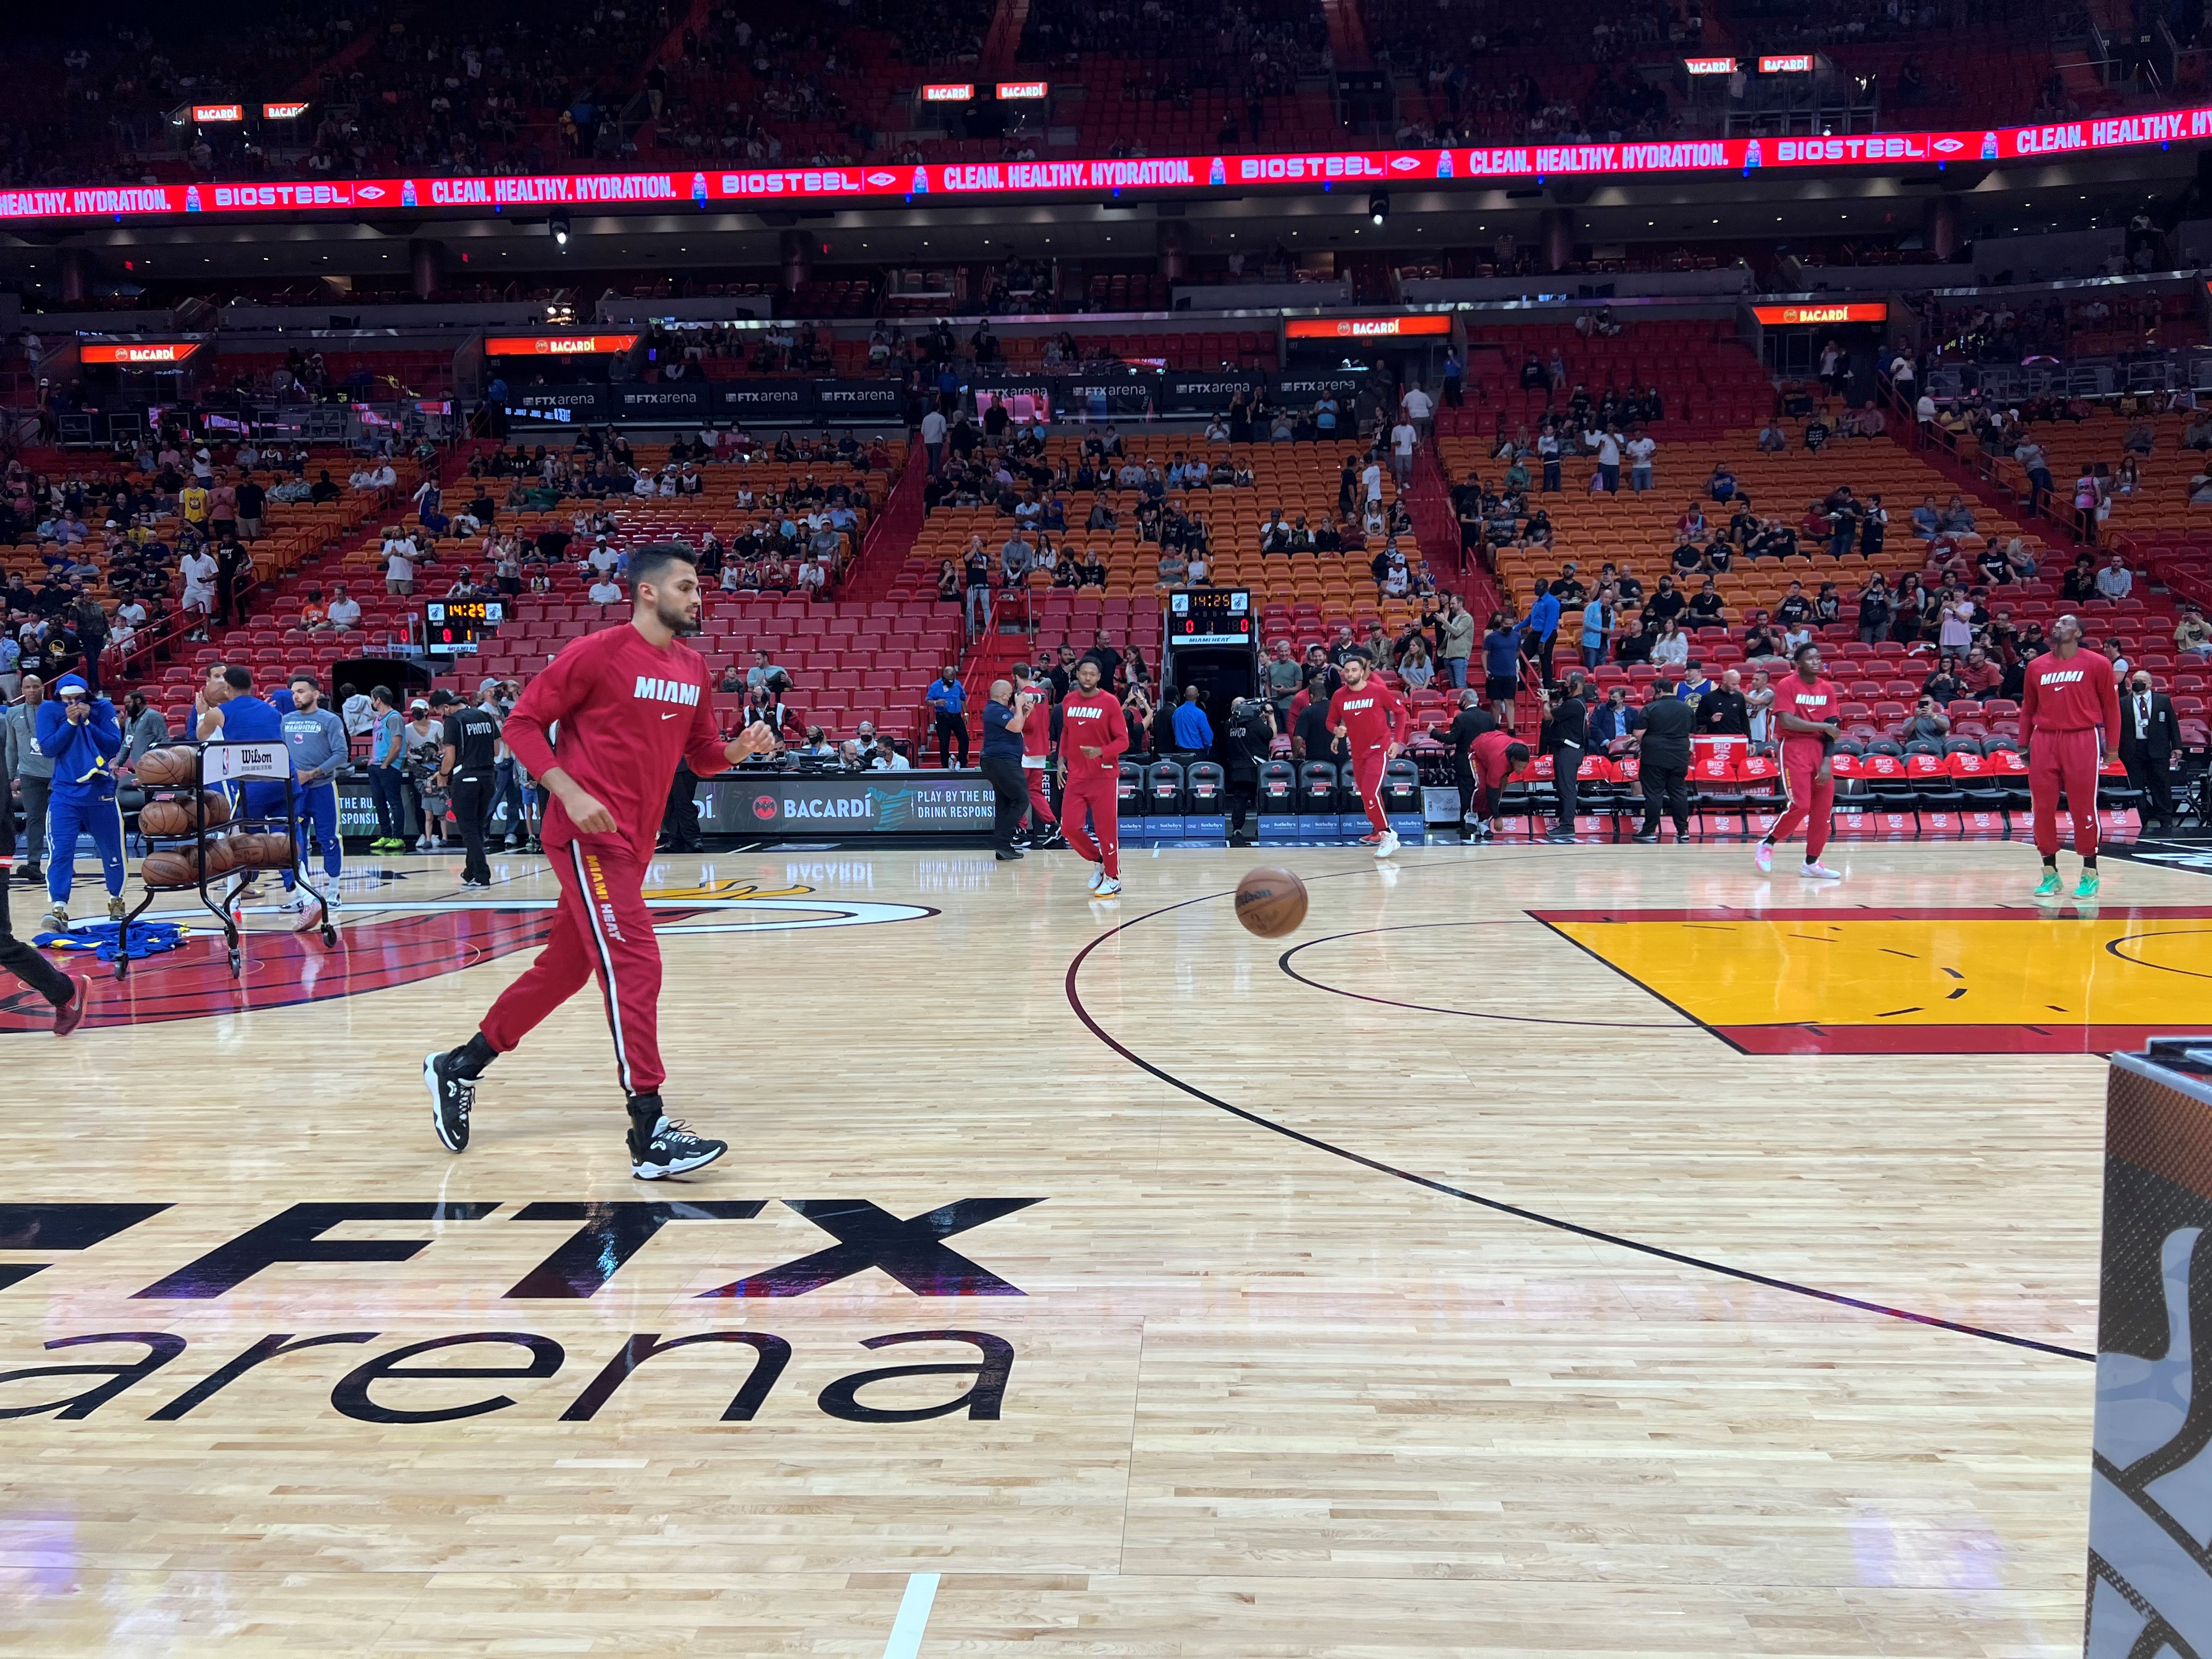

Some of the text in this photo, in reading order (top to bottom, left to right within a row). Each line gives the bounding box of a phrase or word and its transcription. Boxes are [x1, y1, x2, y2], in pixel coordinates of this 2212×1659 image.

[1688, 59, 1731, 73] BACARDÍ
[1764, 56, 1809, 70] BACARDÍ
[928, 86, 969, 99] BACARDÍ
[1001, 83, 1043, 97] BACARDÍ
[198, 106, 238, 119] BACARDÍ
[2017, 114, 2186, 153] CLEAN. HEALTHY.
[1778, 139, 1925, 160] BIOSTEEL
[1470, 150, 1532, 174] CLEAN.
[1536, 147, 1618, 172] HEALTHY.
[1623, 143, 1729, 170] HYDRATION.
[944, 166, 1004, 189] CLEAN.
[1008, 163, 1087, 188] HEALTHY.
[1092, 160, 1194, 185] HYDRATION.
[1241, 157, 1382, 178] BIOSTEEL
[432, 180, 491, 203] CLEAN.
[494, 178, 572, 201] HEALTHY.
[576, 175, 676, 199] HYDRATION.
[722, 172, 859, 193] BIOSTEEL
[74, 189, 171, 212] HYDRATION.
[215, 186, 351, 206] BIOSTEEL
[1799, 307, 1848, 321] BACARDÍ
[1353, 319, 1400, 334] BACARDÍ
[550, 338, 595, 352] BACARDÍ
[129, 347, 174, 360] BACARDÍ
[1085, 385, 1146, 396] FTX arena
[1188, 382, 1250, 393] FTX arena
[1294, 382, 1316, 391] FTX
[535, 394, 594, 405] FTX arena
[636, 393, 697, 404] FTX arena
[737, 392, 798, 402] FTX arena
[834, 391, 894, 401] FTX arena
[1194, 594, 1230, 607] 14:25
[449, 603, 485, 618] 14:25
[1186, 620, 1194, 633] 0
[1240, 618, 1248, 632] 0
[443, 628, 452, 642] 0
[2040, 670, 2084, 686] MIAMI
[634, 676, 700, 707] MIAMI
[1343, 698, 1374, 711] MIAMI
[1795, 694, 1827, 706] MIAMI
[1067, 707, 1102, 719] MIAMI
[466, 723, 492, 736] PHOTO
[241, 749, 272, 764] Wilson
[340, 797, 358, 809] THE
[917, 790, 995, 802] PLAY BY THE RU
[784, 793, 874, 818] BACARDÍ
[917, 806, 996, 817] DRINK RESPONSI
[586, 855, 627, 943] MIAMI HEAT
[128, 1198, 1050, 1299] FTX
[0, 1330, 1014, 1424] arena
